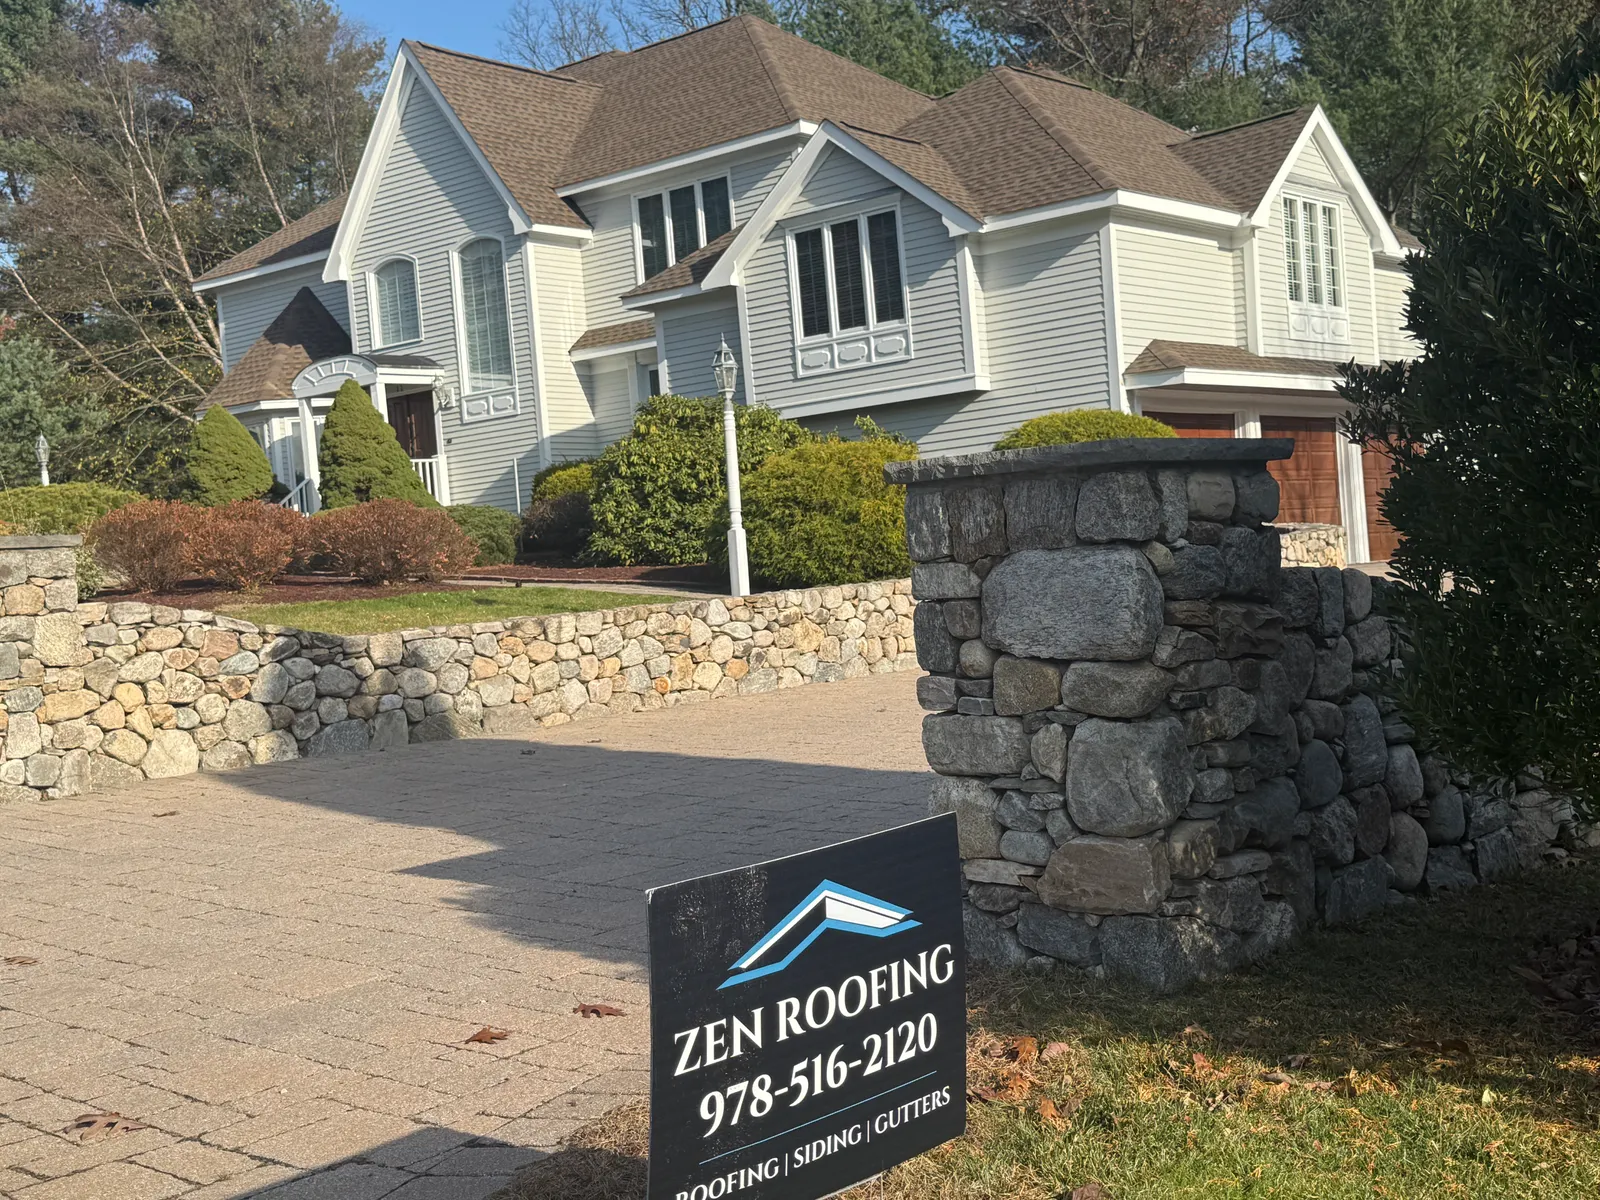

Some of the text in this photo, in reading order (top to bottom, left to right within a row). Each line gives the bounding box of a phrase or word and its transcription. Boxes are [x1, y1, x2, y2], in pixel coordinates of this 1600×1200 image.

[673, 944, 955, 1077] ZEN ROOFING
[699, 1012, 938, 1138] 978-516-2120
[793, 1124, 862, 1168] SIDING
[874, 1085, 951, 1135] GUTTERS
